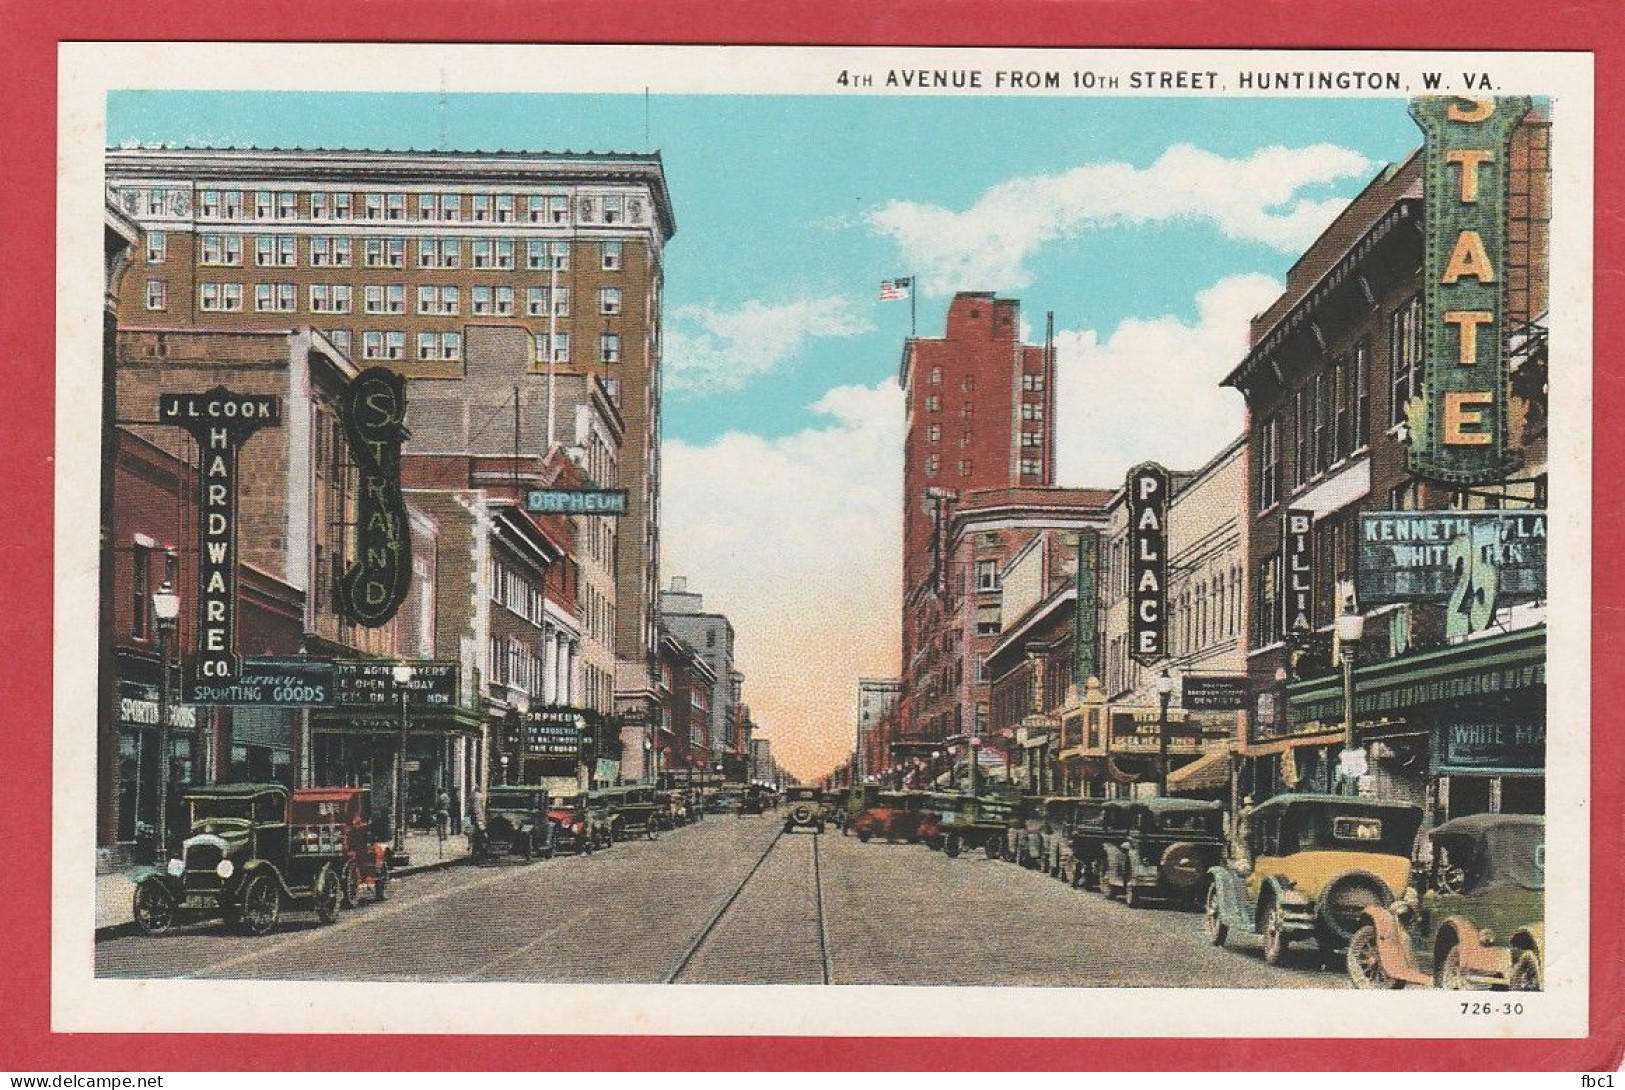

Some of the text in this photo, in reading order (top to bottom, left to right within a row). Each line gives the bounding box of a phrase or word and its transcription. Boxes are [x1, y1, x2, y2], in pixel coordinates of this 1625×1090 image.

[837, 70, 1501, 92] 4TH AVENUE FROM 10TH STREET, HUNTINGTON, W. VA.
[208, 401, 270, 418] COOK
[366, 393, 396, 606] STRAND
[528, 491, 623, 510] ORPHEUM
[207, 427, 228, 652] HARDWARE
[1365, 518, 1471, 541] KENNETH
[1138, 477, 1160, 653] PALACE
[202, 660, 232, 677] CO.
[193, 685, 262, 701] SPORTING
[272, 684, 325, 702] GOODS
[1460, 1002, 1525, 1016] 726-30
